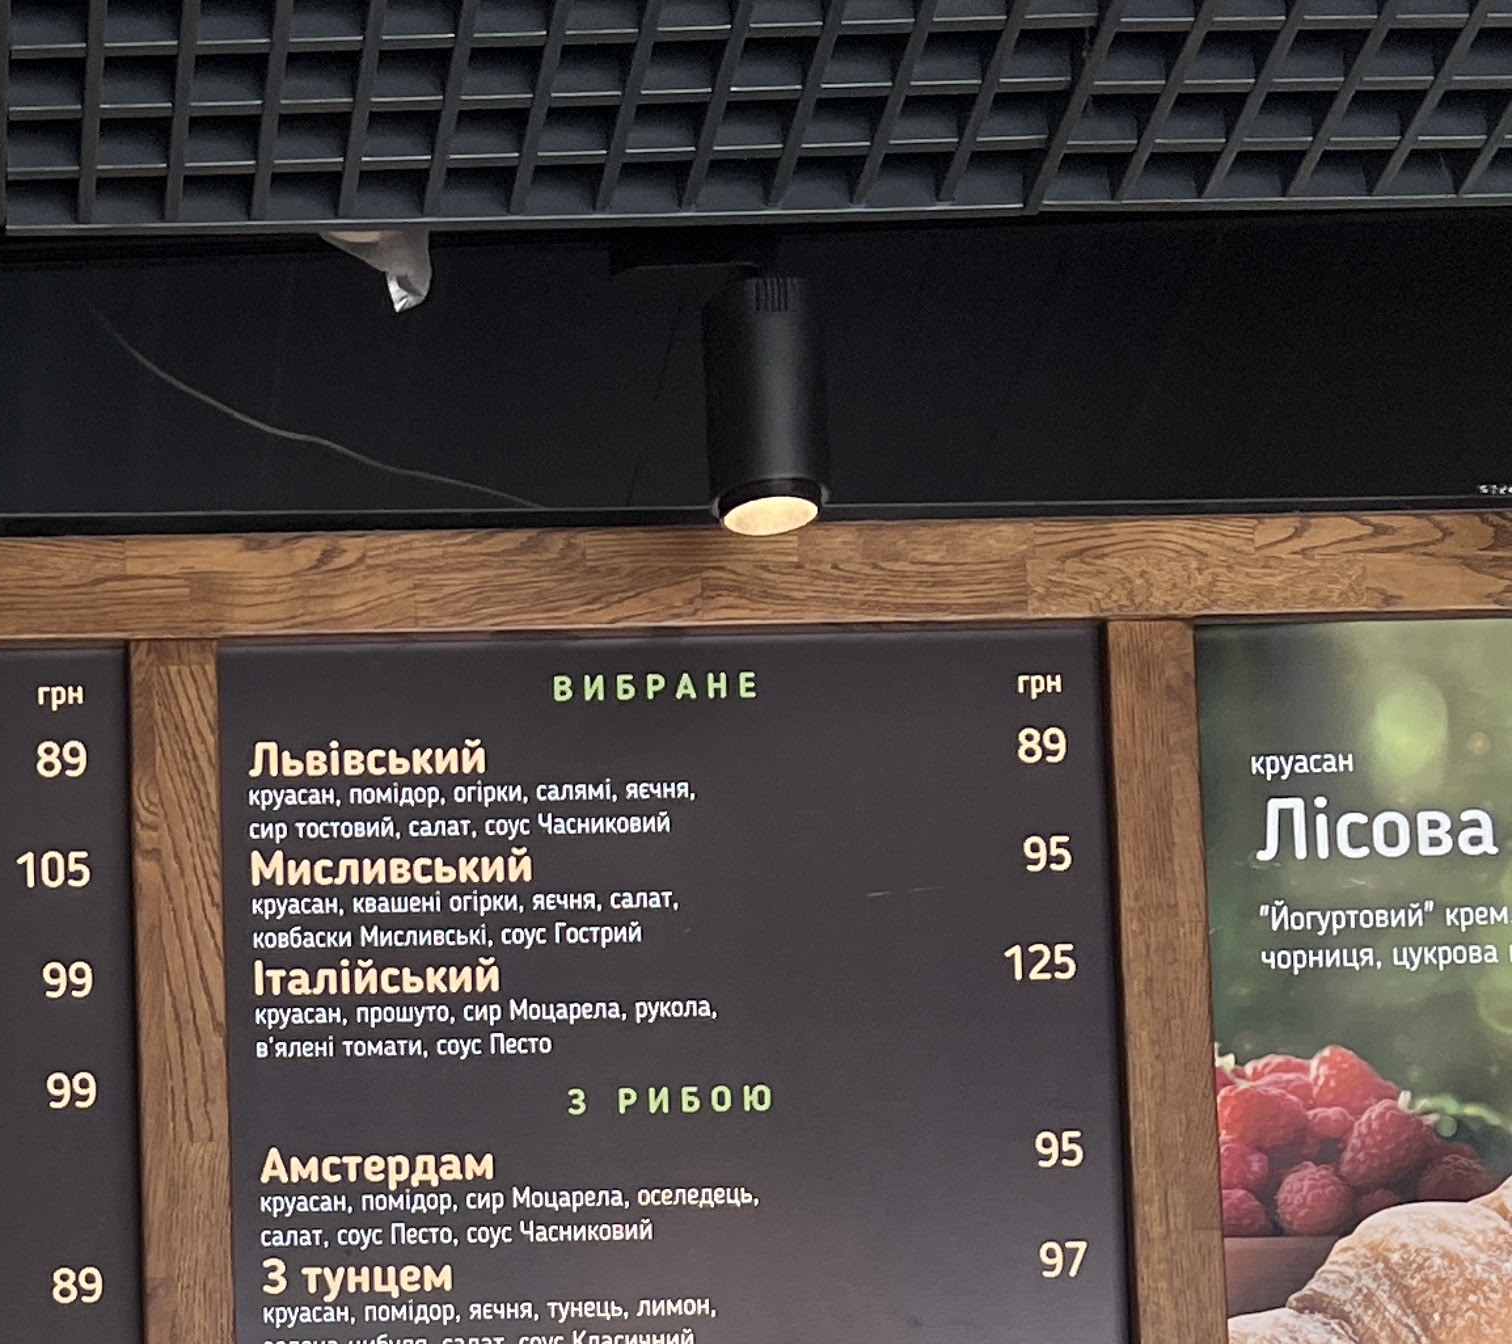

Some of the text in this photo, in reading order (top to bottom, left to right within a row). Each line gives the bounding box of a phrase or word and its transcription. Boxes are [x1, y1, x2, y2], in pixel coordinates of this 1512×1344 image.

[36, 684, 85, 712] грн
[553, 671, 757, 702] ВИБРАНЕ
[1016, 673, 1063, 700] грн
[36, 740, 88, 778] 89
[248, 738, 486, 778] Львівський
[1017, 726, 1068, 764] 89
[1250, 752, 1354, 781] круасан
[1255, 796, 1499, 862] Лісова
[16, 850, 91, 889] 105
[251, 846, 533, 887] Мисливський
[1022, 835, 1073, 873] 95
[253, 920, 642, 950] ковбаски Мисливські, соус Гострий
[1259, 899, 1511, 935] "Йогуртовий" крем
[254, 956, 500, 996] Італійський
[1003, 943, 1078, 982] 125
[1260, 944, 1500, 975] чорниця, цукрова
[42, 961, 94, 999] 99
[256, 1032, 552, 1061] в'ялені томати, соус Песто
[46, 1071, 98, 1109] 99
[567, 1084, 772, 1116] З РИБОЮ
[1034, 1130, 1085, 1168] 95
[260, 1146, 494, 1192] Амстердам
[1039, 1240, 1088, 1278] 97
[52, 1266, 104, 1304] 89
[262, 1257, 453, 1303] З тунцем
[263, 1298, 716, 1329] круасан, помідор, яєчня, тунець, лимон,
